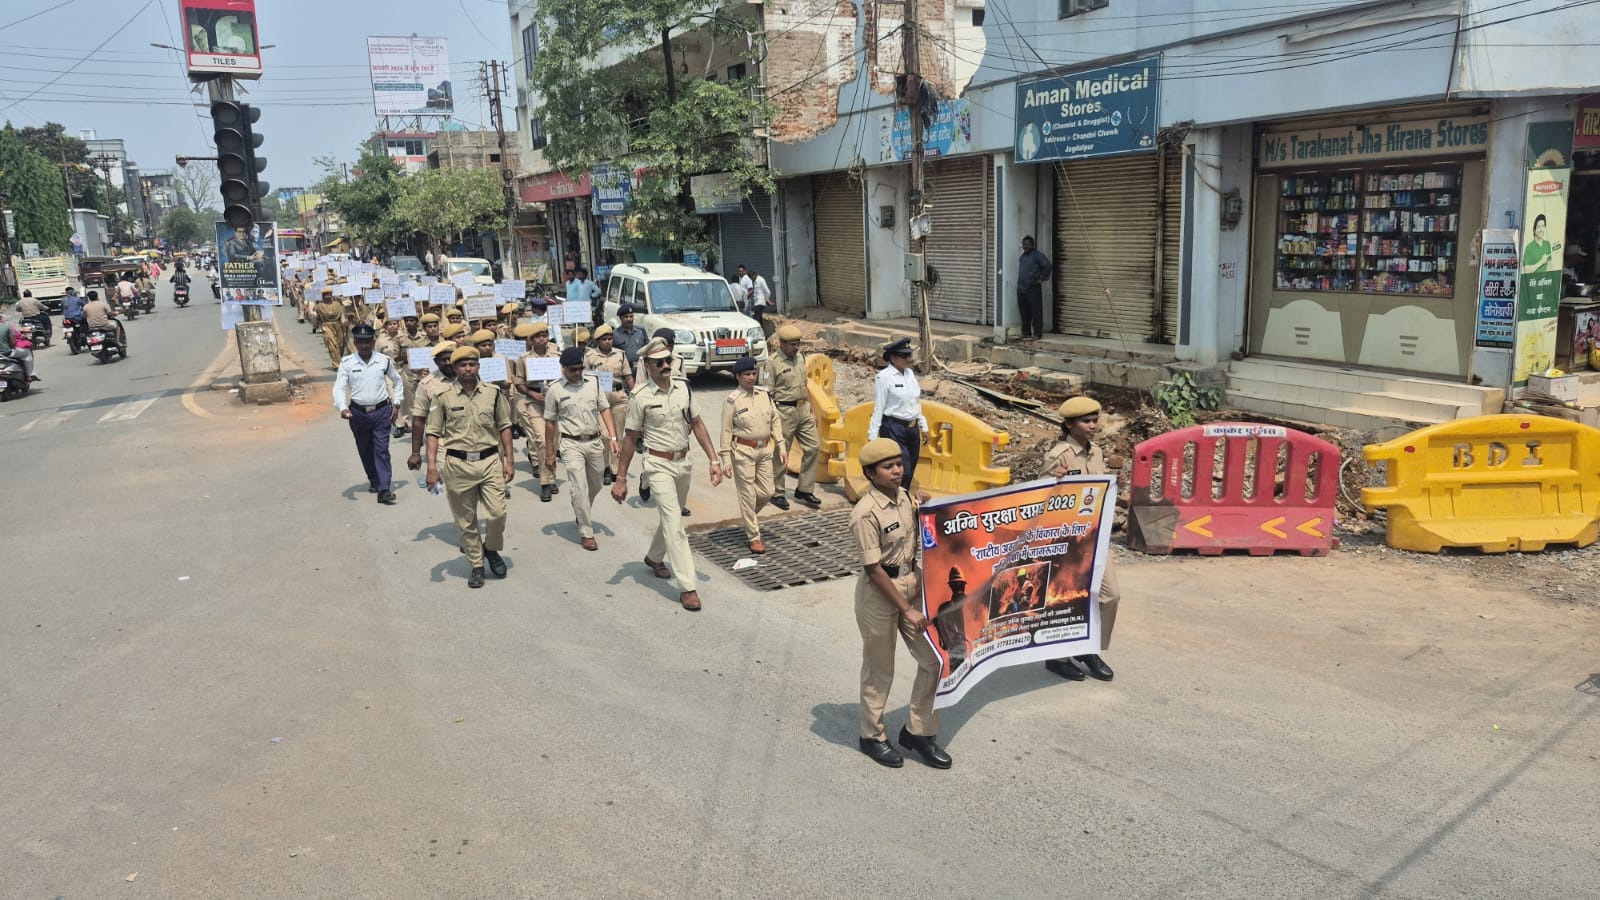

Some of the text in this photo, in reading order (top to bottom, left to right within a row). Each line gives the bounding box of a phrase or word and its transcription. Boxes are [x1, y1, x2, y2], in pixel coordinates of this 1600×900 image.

[212, 57, 237, 66] TILES
[1024, 67, 1149, 109] Aman Medical
[1061, 101, 1102, 117] Stores
[1052, 121, 1076, 131] (Chemist
[1083, 115, 1110, 126] Druggist)
[1044, 135, 1066, 143] Address
[1072, 130, 1097, 140] Chandni
[1097, 127, 1119, 137] Chowk
[1264, 119, 1488, 162] M/s Tarakanat Jha Kirana Stores
[1485, 281, 1500, 297] सीटी
[943, 511, 978, 535] अग्नि
[981, 507, 1017, 532] सुरक्षा
[1047, 494, 1076, 511] 2026
[1035, 527, 1060, 540] विकास
[1061, 523, 1070, 537] के
[1028, 543, 1068, 558] जागरूकता
